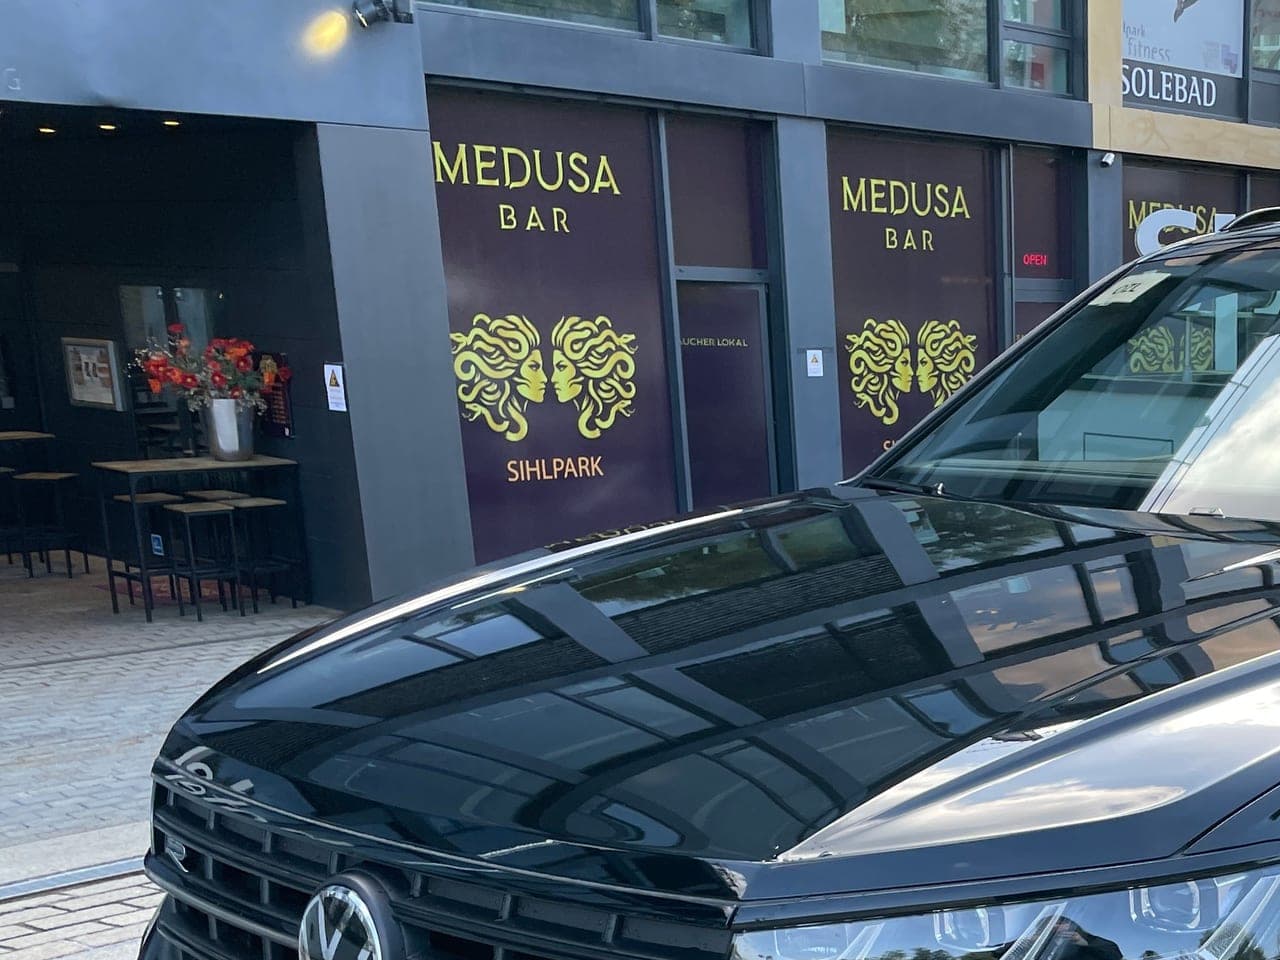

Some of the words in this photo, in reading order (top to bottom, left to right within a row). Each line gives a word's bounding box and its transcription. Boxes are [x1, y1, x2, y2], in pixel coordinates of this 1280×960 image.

[1121, 64, 1217, 107] SOLEBAD
[432, 141, 622, 195] MEDUSA
[841, 176, 971, 219] MEDUSA
[499, 204, 570, 233] BAR
[885, 227, 934, 251] BAR
[1023, 253, 1048, 266] OPEN
[716, 338, 749, 347] LOKAL
[507, 456, 604, 482] SIHLPARK
